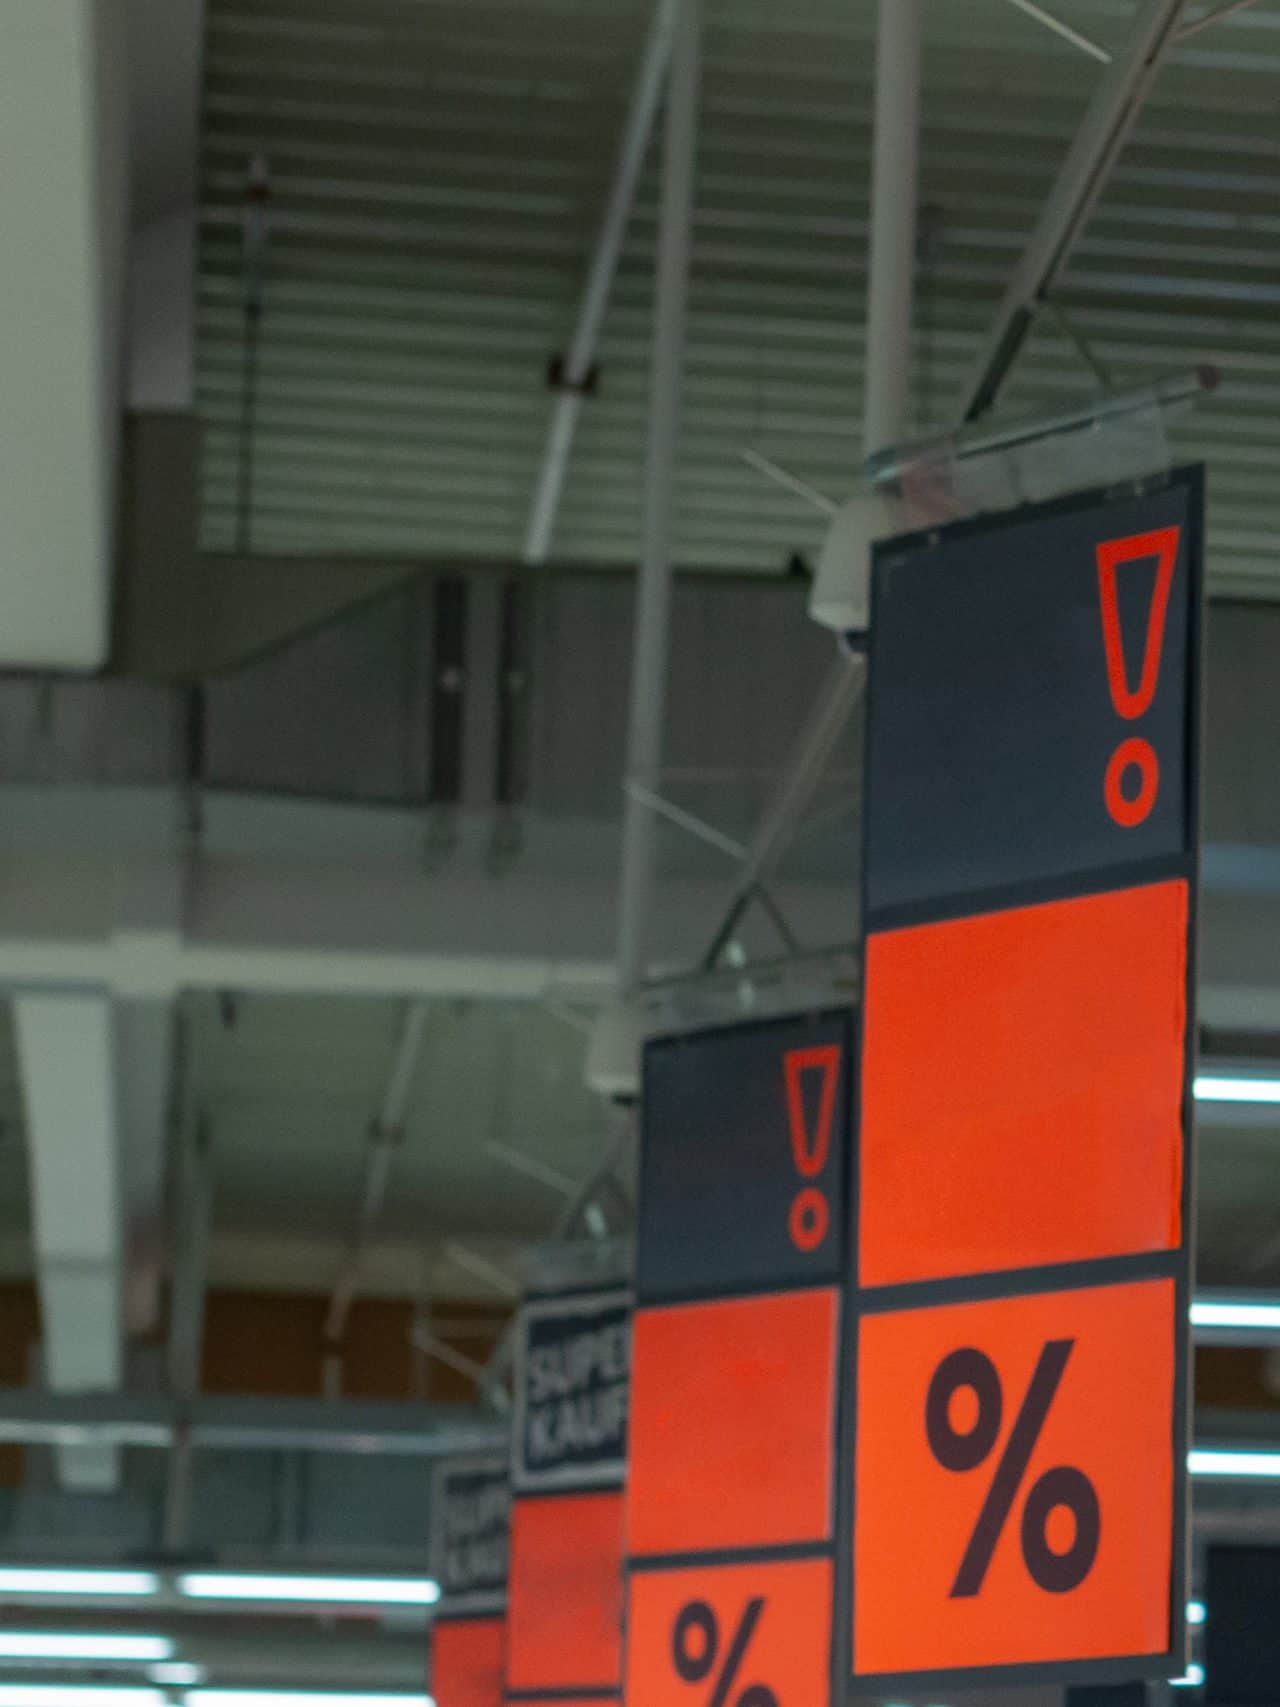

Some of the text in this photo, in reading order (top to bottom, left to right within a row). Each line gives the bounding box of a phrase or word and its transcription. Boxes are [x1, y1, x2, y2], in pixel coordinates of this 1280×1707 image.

[1097, 527, 1179, 827] !
[787, 1047, 837, 1249] !
[924, 1338, 1102, 1599] %
[671, 1597, 780, 1707] %
